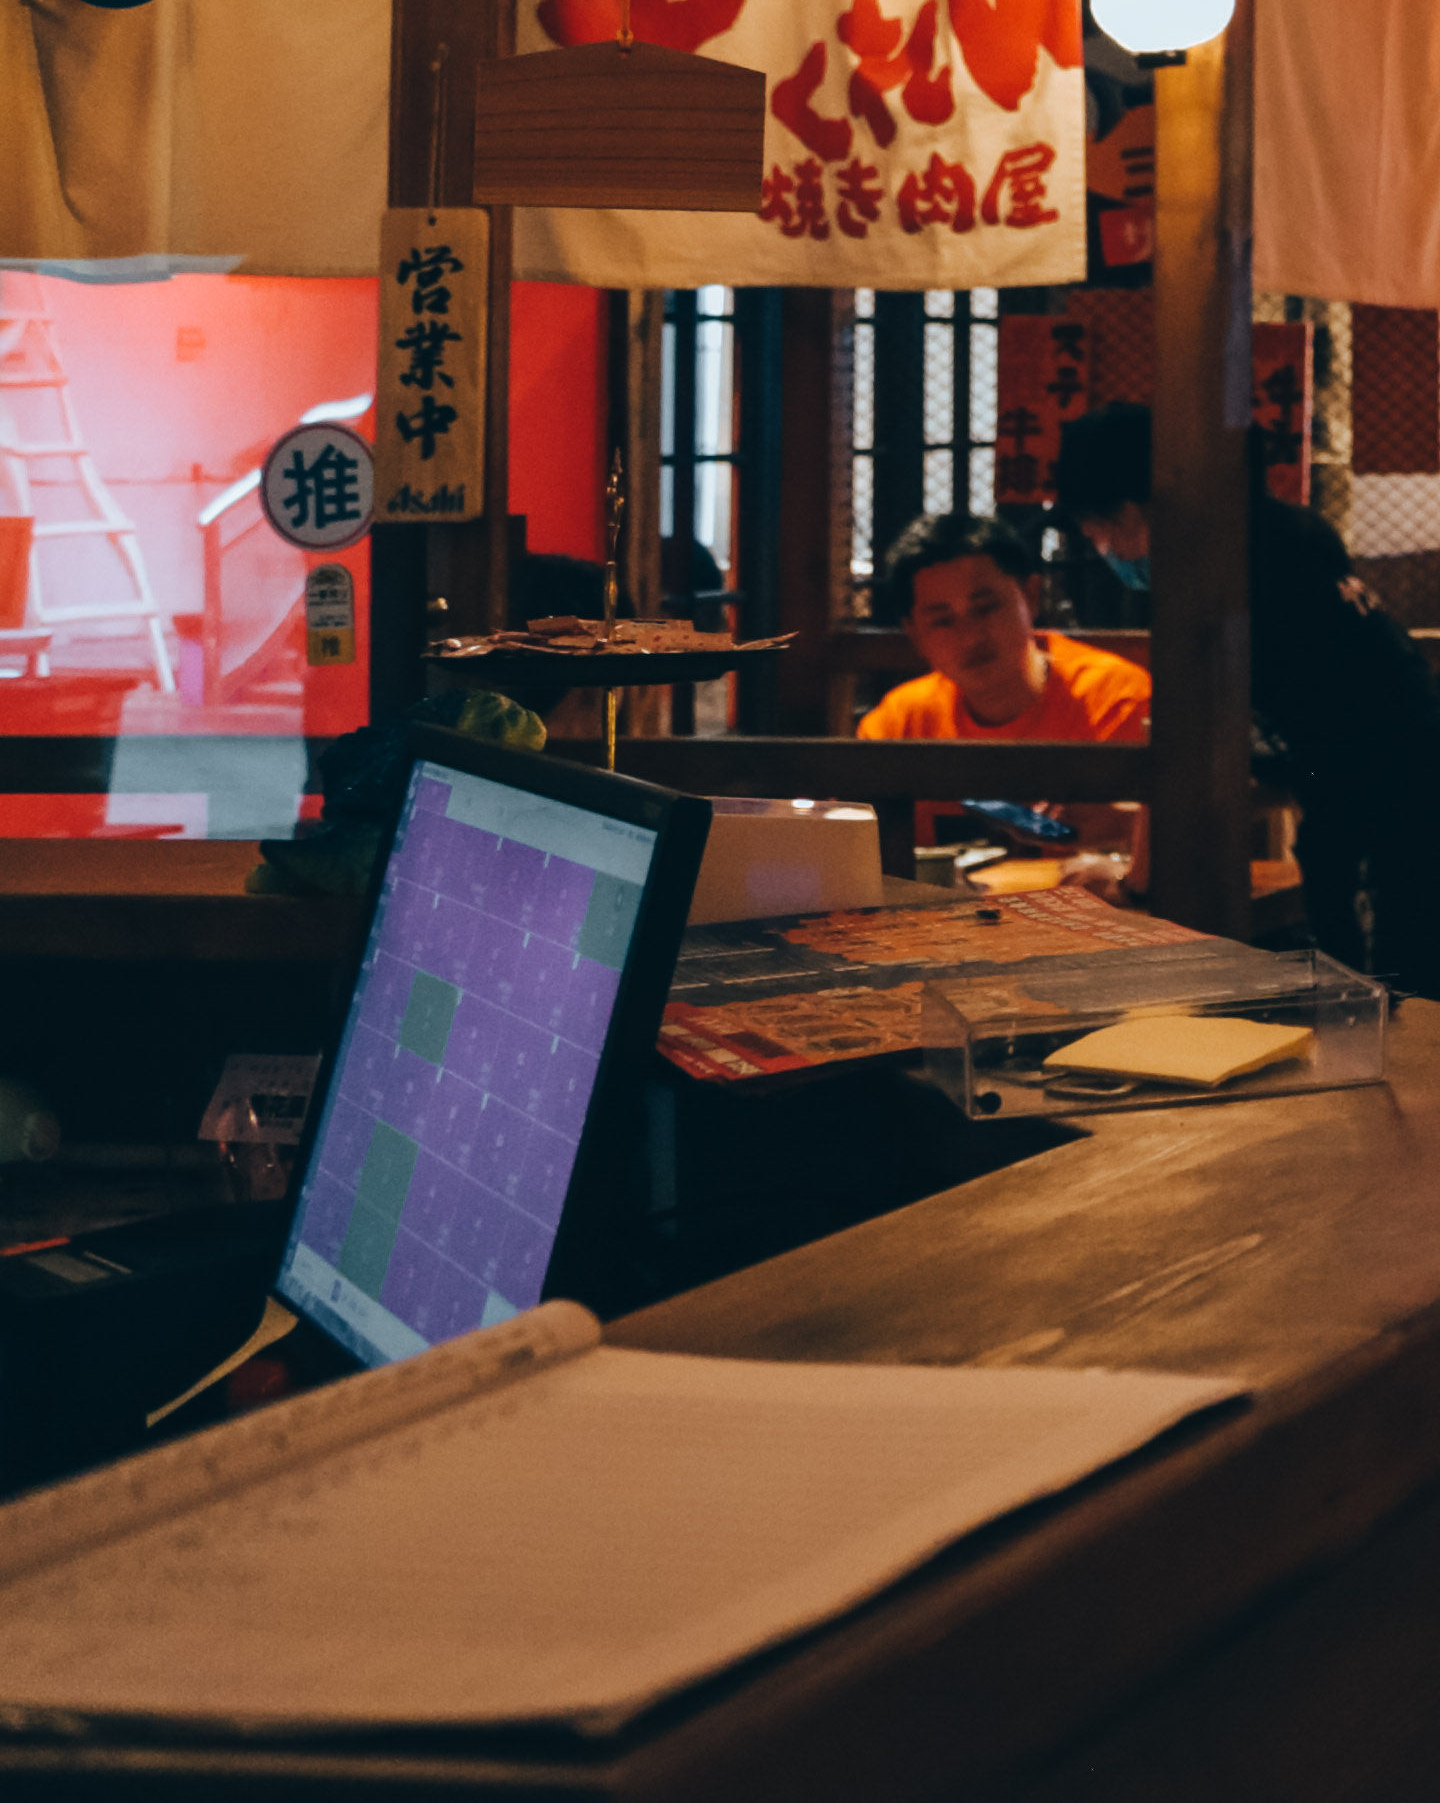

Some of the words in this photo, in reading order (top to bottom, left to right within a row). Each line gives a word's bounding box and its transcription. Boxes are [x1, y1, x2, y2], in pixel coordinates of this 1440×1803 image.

[757, 143, 1061, 241] 焼き肉屋
[396, 244, 465, 461] 営業中
[283, 443, 362, 530] 推
